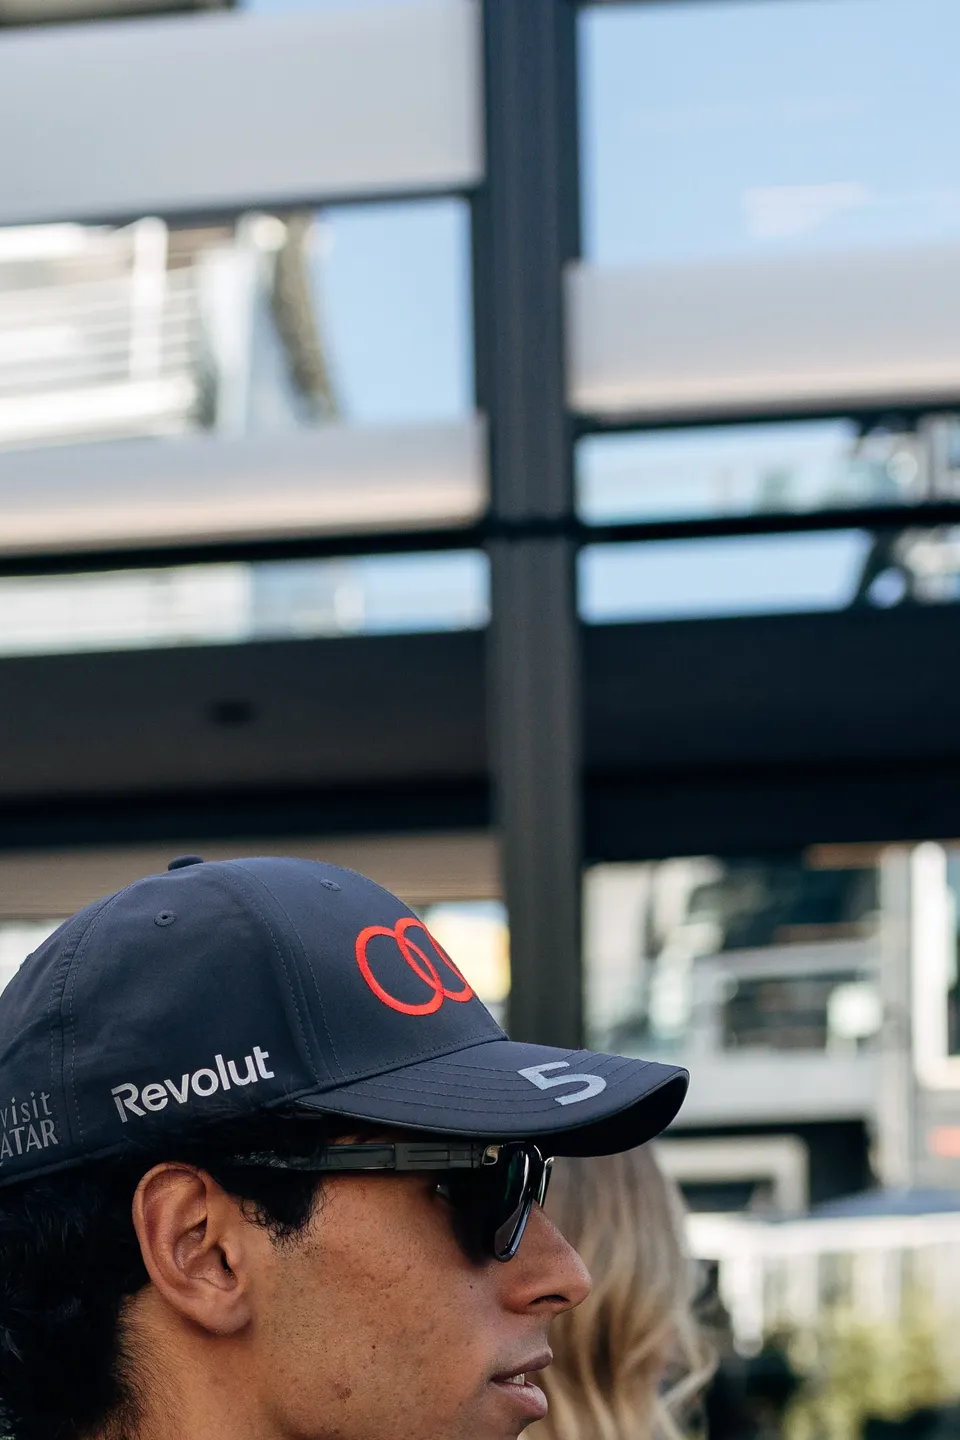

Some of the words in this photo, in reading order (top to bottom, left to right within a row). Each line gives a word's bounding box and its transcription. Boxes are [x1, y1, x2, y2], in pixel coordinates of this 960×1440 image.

[111, 1046, 275, 1123] Revolut
[517, 1061, 607, 1106] 5
[0, 1091, 52, 1127] visit
